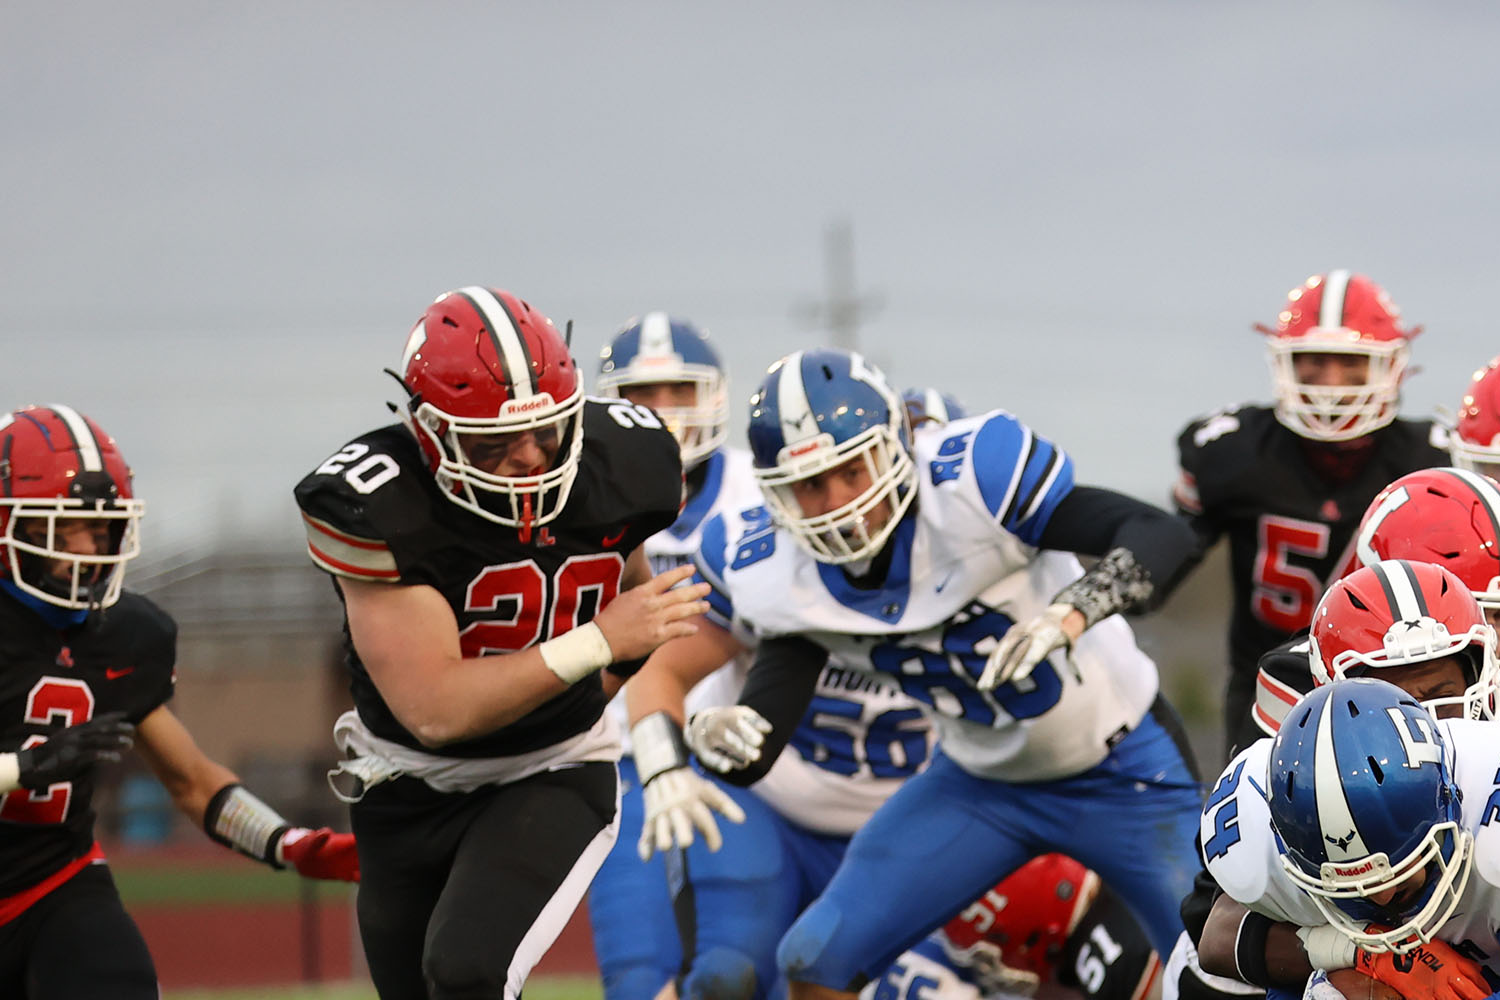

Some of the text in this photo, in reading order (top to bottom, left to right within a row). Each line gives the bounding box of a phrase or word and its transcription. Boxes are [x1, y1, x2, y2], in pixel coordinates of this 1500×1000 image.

[507, 397, 549, 414] Riddell
[315, 443, 401, 495] 20
[459, 551, 625, 660] 20
[1203, 757, 1249, 865] 34
[1334, 862, 1373, 877] Riddell
[1075, 923, 1123, 994] 51
